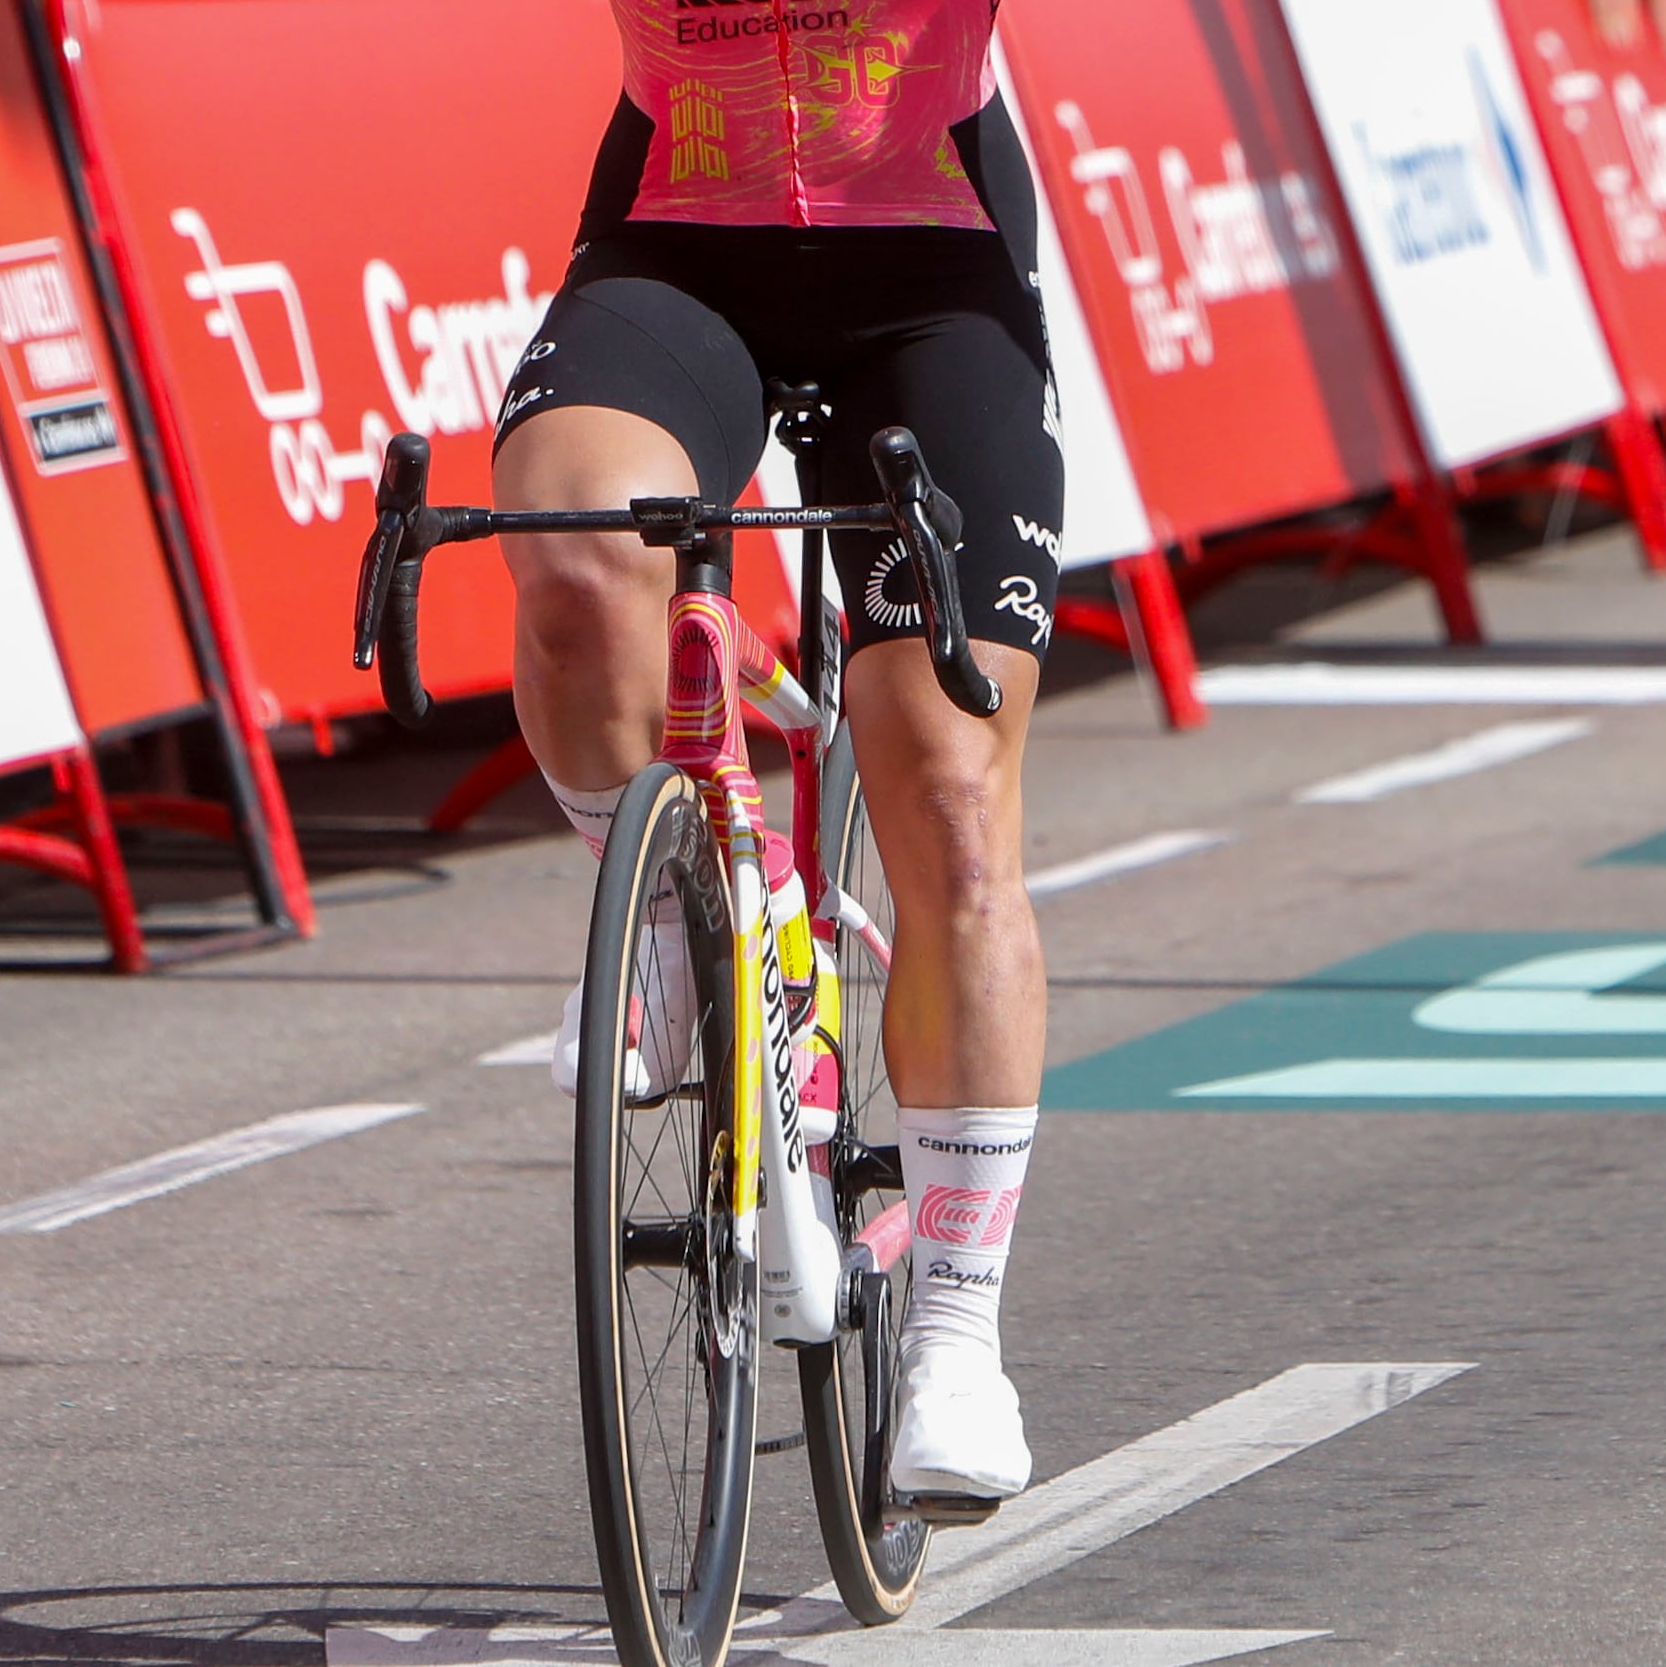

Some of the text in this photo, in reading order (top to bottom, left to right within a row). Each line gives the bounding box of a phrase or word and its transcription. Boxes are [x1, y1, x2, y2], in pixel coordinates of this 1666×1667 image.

[677, 8, 849, 46] Education
[731, 509, 833, 524] cannondale
[927, 1261, 1000, 1289] Rapha
